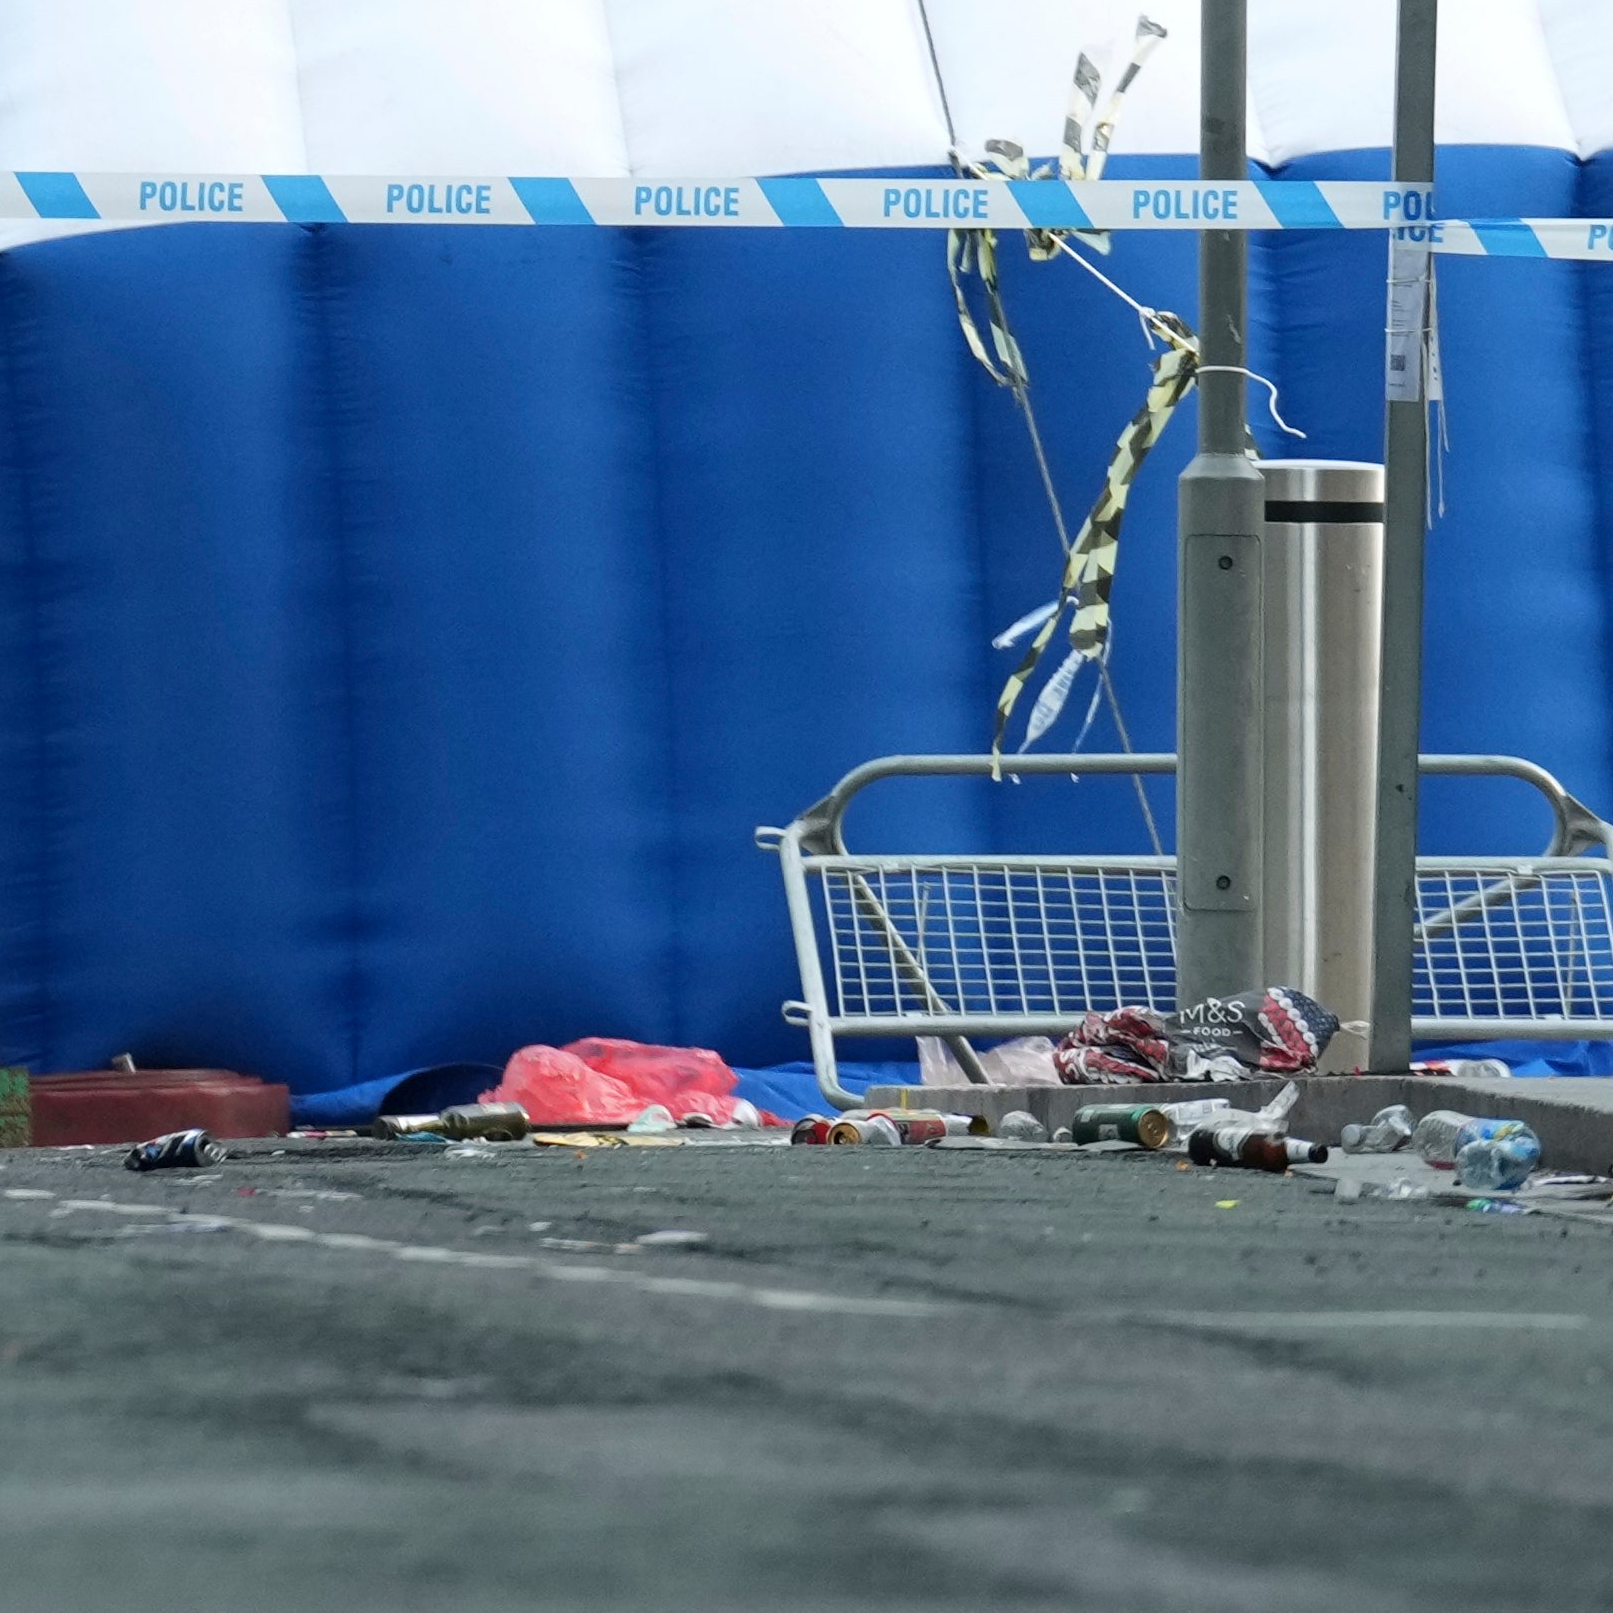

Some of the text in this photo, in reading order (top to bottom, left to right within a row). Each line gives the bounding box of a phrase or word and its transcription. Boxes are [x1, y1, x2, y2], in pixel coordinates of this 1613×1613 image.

[139, 180, 245, 215] POLICE
[386, 183, 492, 216] POLICE
[634, 185, 741, 219] POLICE
[883, 188, 990, 221] POLICE
[1132, 190, 1240, 223] POLICE
[1178, 996, 1246, 1025] M&S
[1192, 1027, 1231, 1038] FOOD
